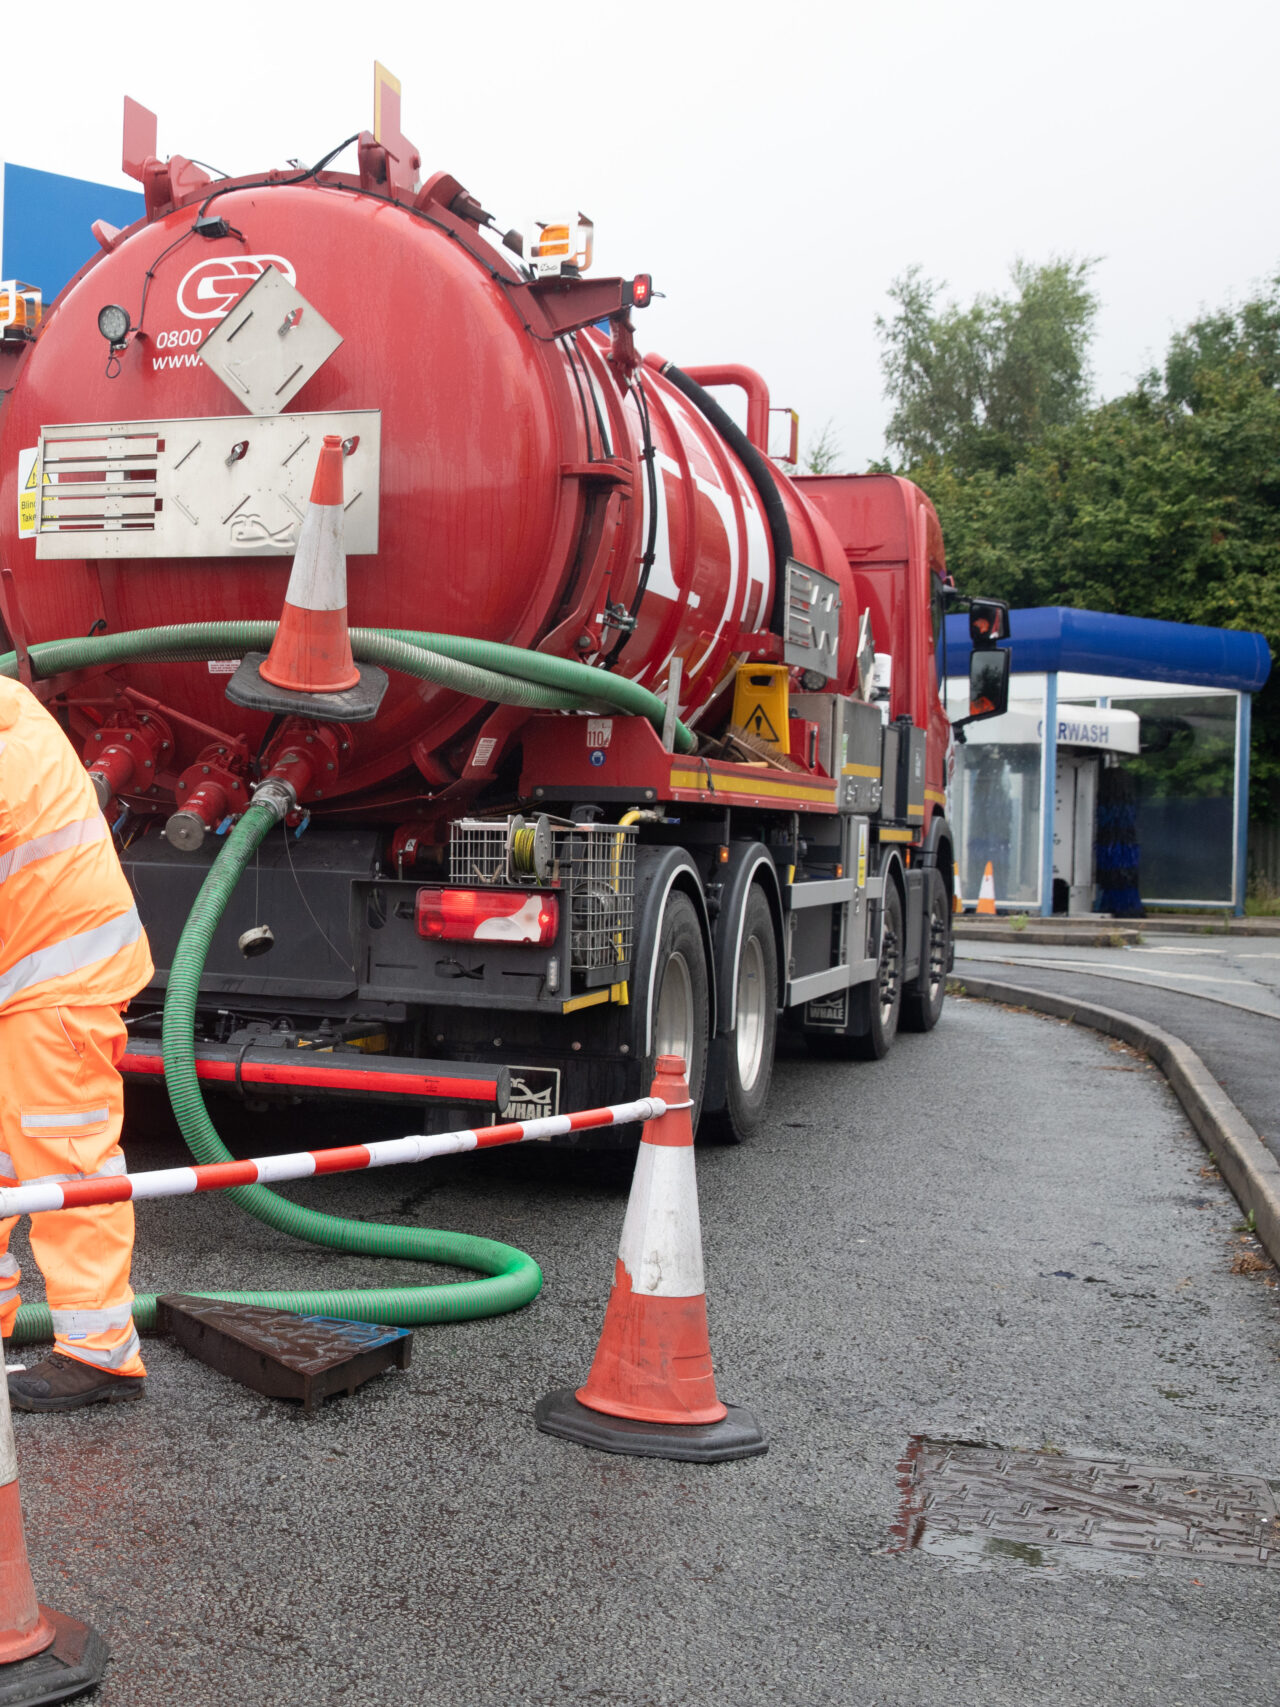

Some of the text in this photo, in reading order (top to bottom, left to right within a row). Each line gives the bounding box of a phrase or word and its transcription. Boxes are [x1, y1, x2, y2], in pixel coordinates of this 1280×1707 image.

[156, 328, 202, 349] 0800
[152, 353, 203, 371] www.
[1037, 720, 1110, 744] CRWASH
[810, 1007, 844, 1020] WHALE
